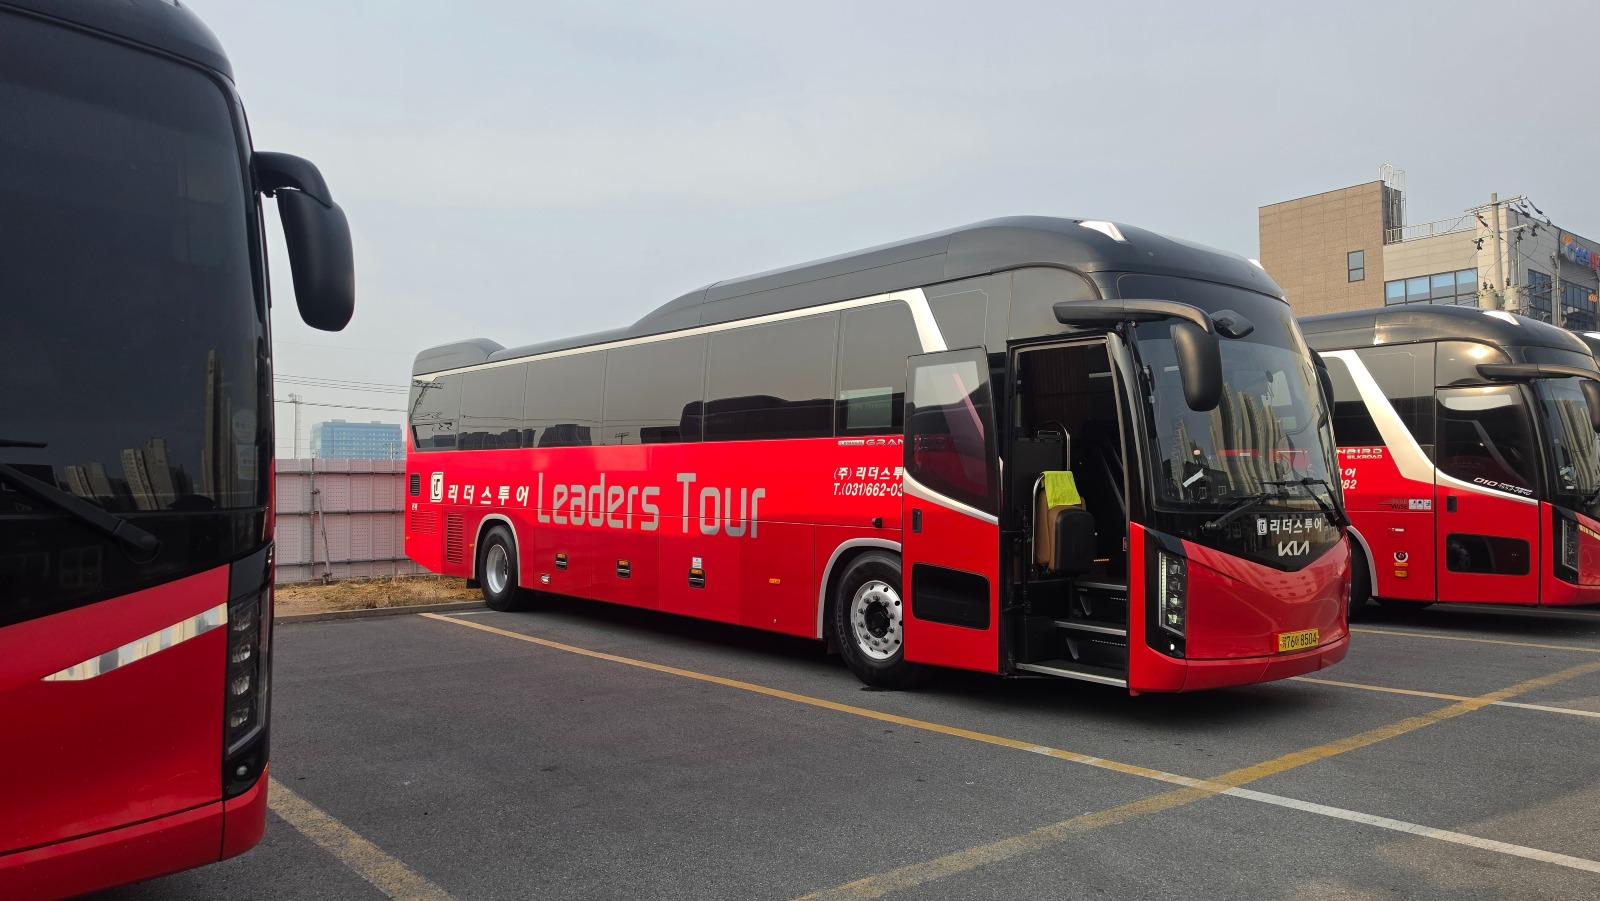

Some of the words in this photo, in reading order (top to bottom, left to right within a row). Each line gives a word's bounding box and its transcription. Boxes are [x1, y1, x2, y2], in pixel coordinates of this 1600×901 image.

[833, 467, 852, 480] (주)
[1341, 479, 1357, 490] 82
[447, 484, 530, 507] 리더스투어
[537, 472, 661, 531] Leaders
[676, 472, 766, 539] Tour
[1269, 517, 1322, 535] 리더스투어
[1278, 540, 1310, 557] KIA
[1300, 633, 1316, 646] 8504
